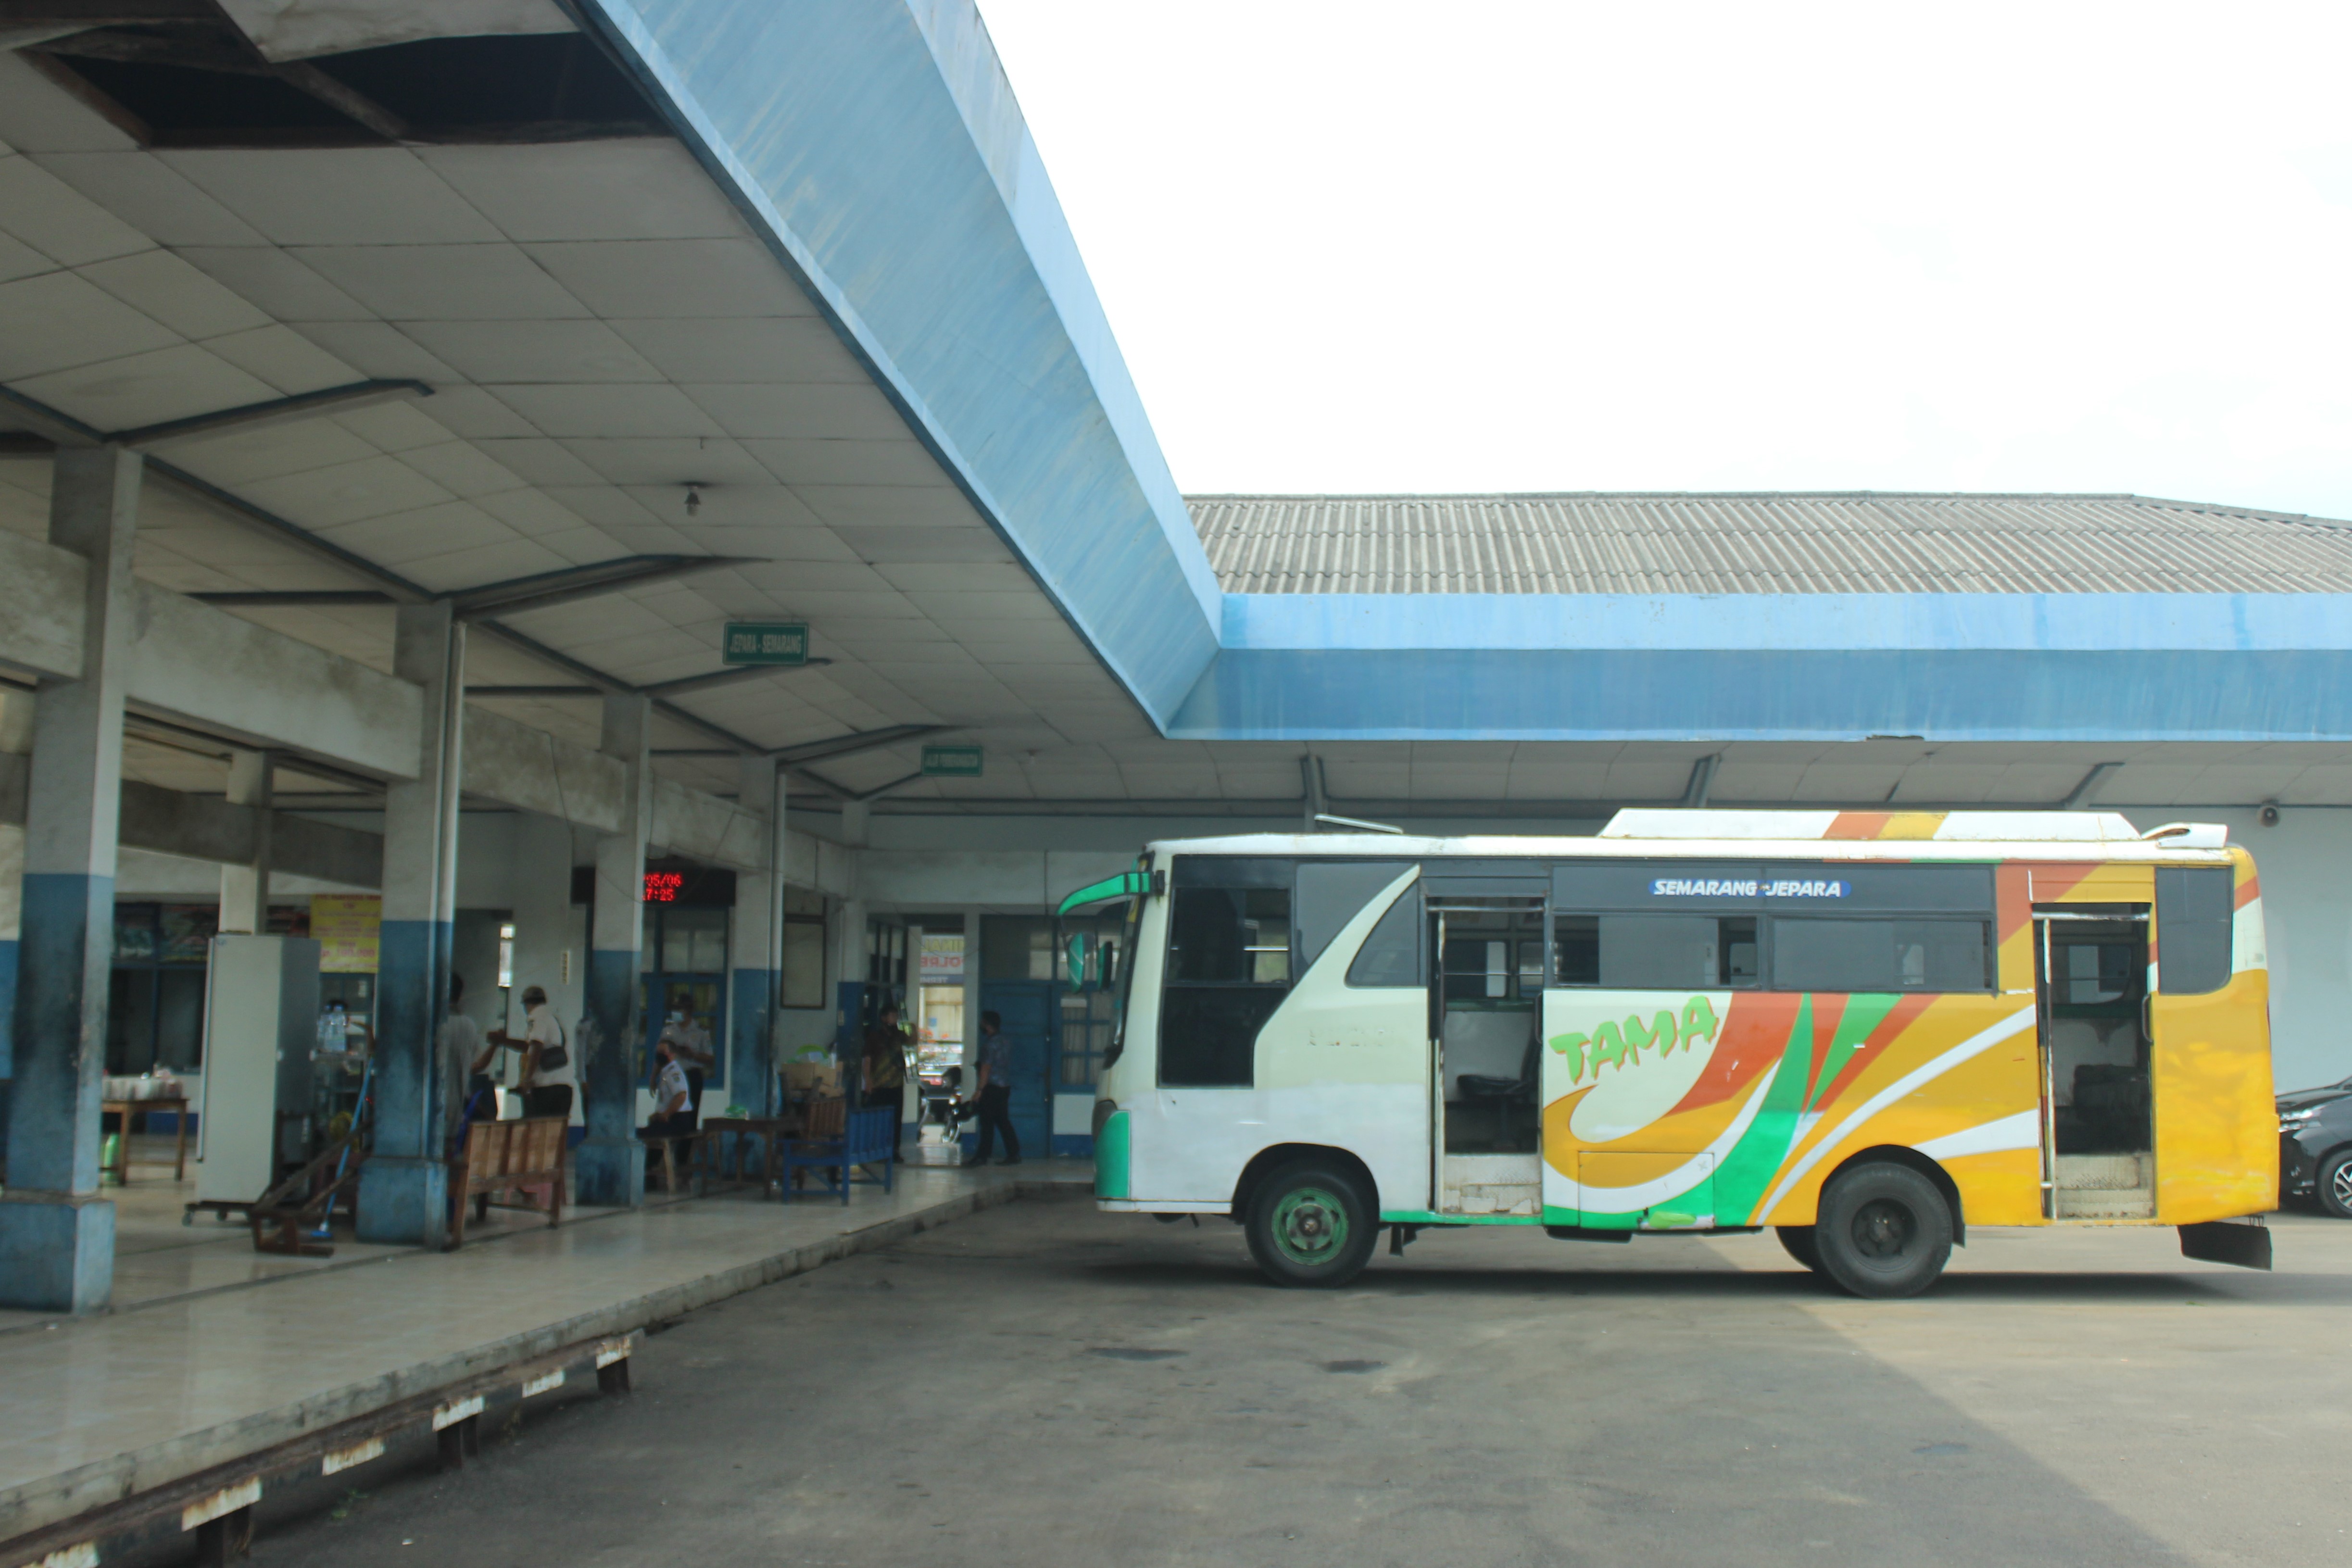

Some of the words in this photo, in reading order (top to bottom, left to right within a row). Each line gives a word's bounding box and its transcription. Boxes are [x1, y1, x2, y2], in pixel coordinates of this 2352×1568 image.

[643, 873, 681, 887] 05/06
[1653, 878, 1758, 897] SEMARANG
[1765, 880, 1841, 897] JEPARA
[1548, 995, 1720, 1086] TAMA
